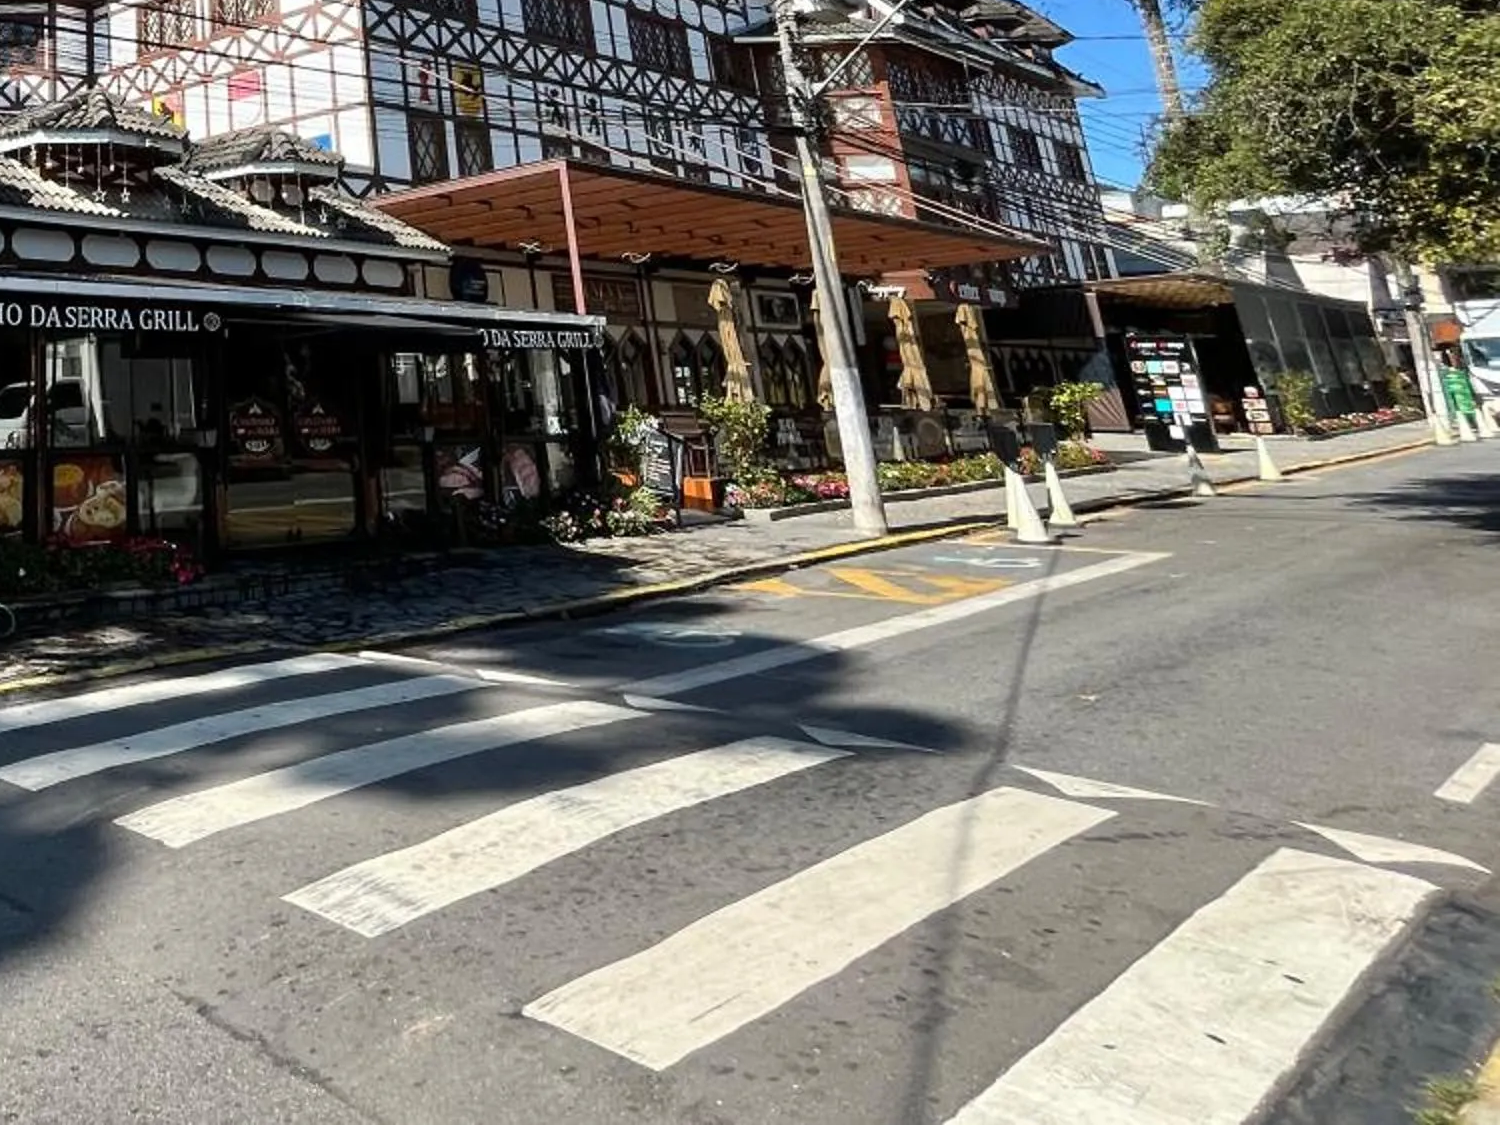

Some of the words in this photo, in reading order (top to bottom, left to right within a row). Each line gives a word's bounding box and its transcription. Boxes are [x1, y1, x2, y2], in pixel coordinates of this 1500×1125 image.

[30, 304, 62, 328] DA
[64, 306, 135, 331] SERRA
[139, 309, 199, 332] GRILL
[491, 329, 511, 348] DA
[512, 330, 555, 348] SERRA
